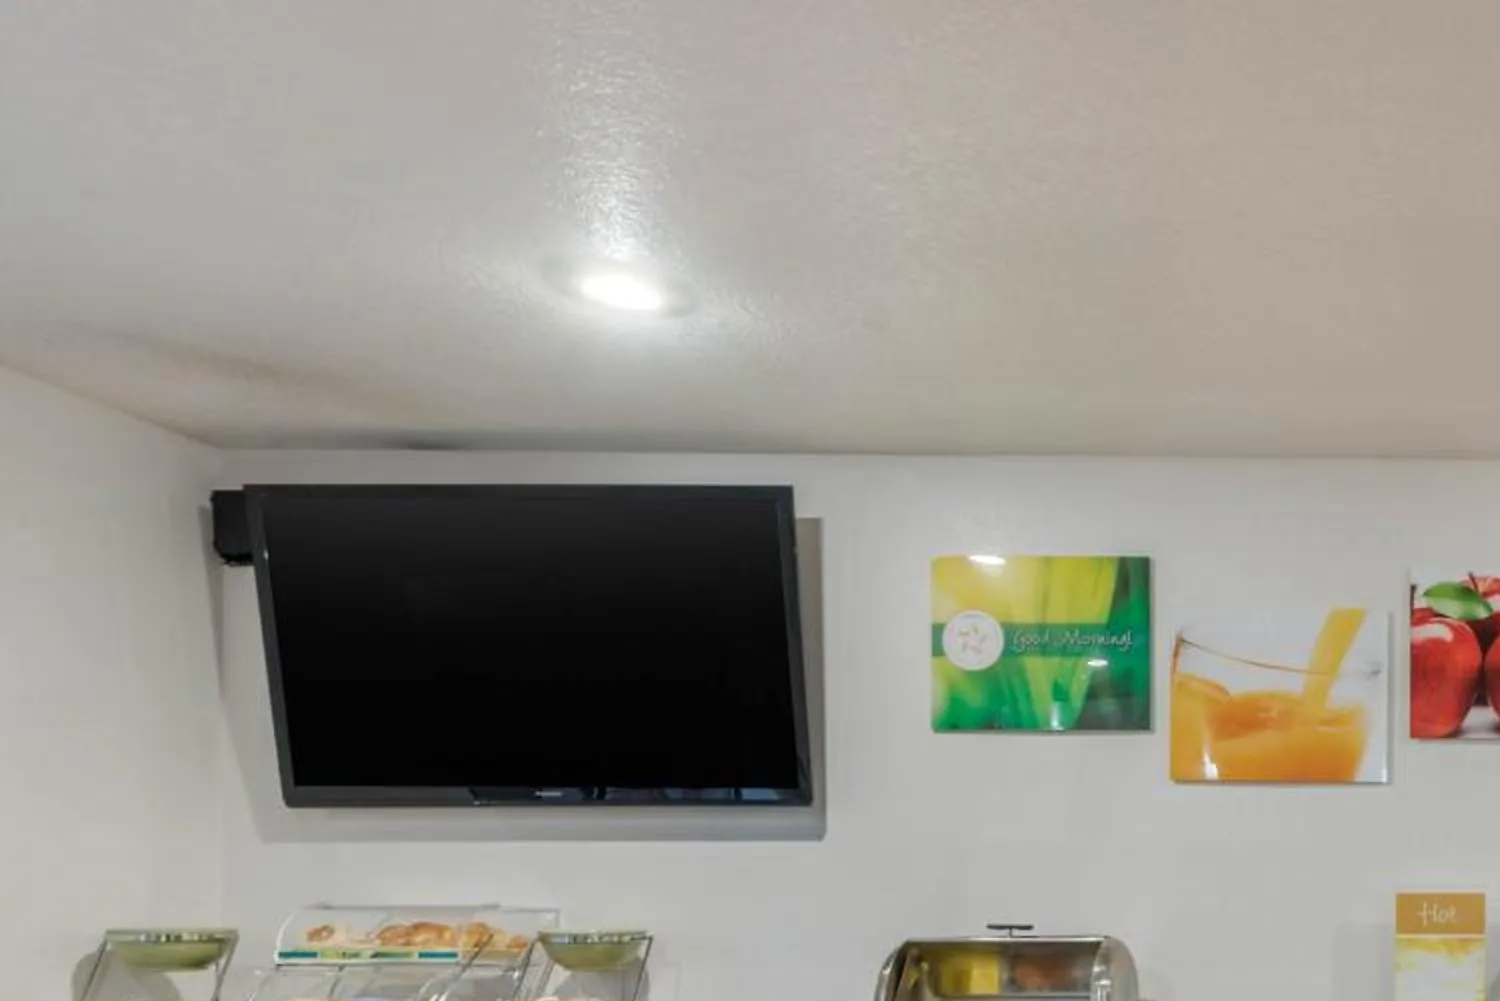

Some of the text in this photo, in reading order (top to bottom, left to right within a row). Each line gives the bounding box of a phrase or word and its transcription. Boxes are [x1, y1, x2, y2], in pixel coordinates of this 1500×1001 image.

[1013, 628, 1134, 652] Good Morning!
[1416, 899, 1459, 927] Hot
